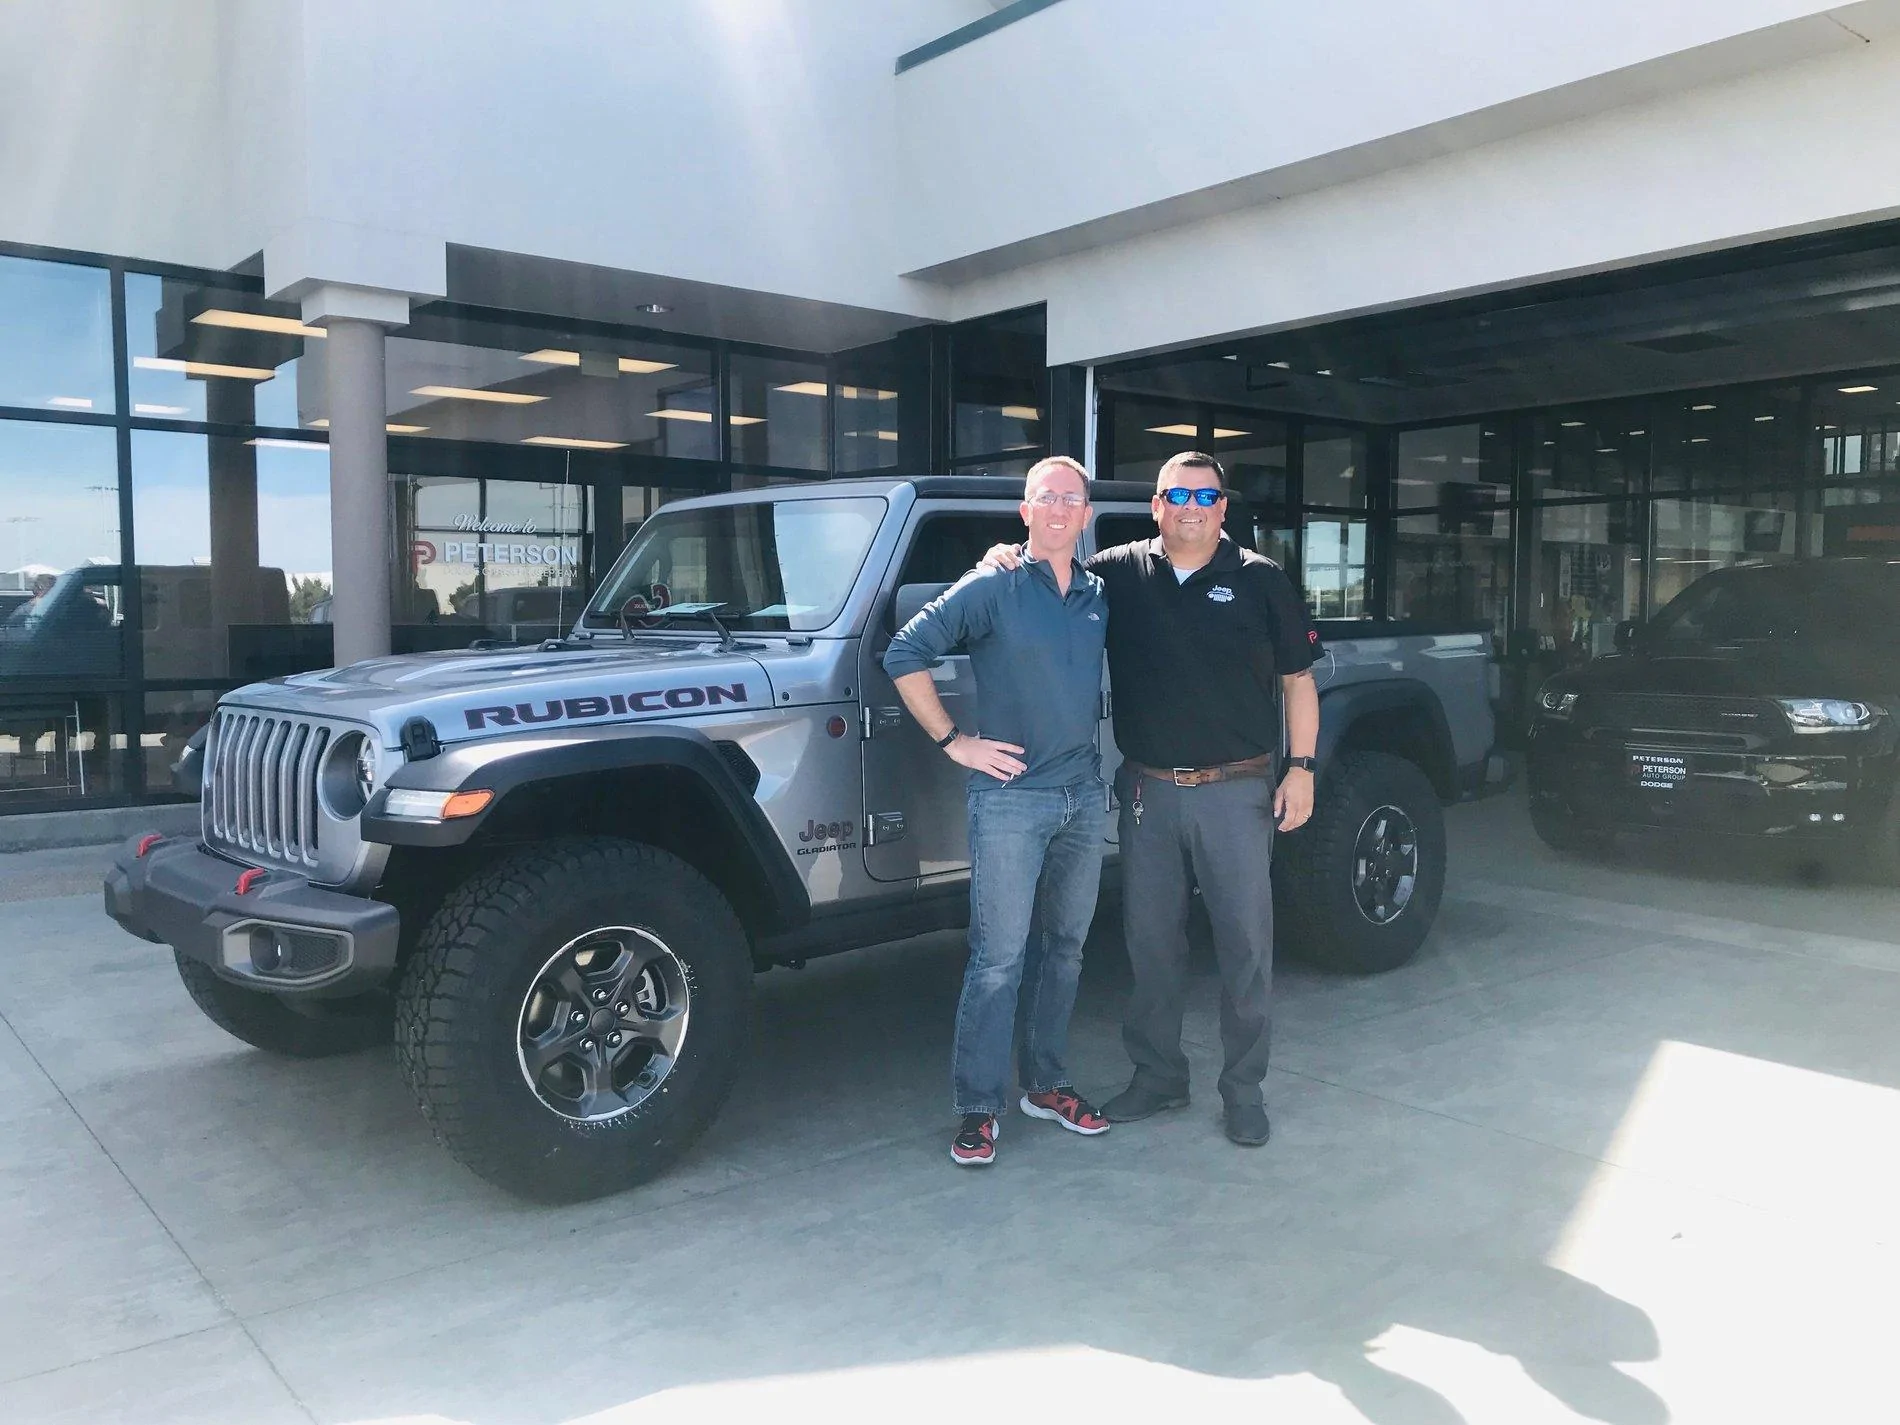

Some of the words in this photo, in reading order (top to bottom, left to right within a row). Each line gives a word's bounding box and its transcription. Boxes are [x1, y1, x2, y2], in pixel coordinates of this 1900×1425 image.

[453, 513, 521, 533] Welcome
[522, 518, 537, 534] to
[444, 541, 578, 566] PETERSON
[1212, 584, 1232, 595] Jeep
[464, 683, 748, 730] RUBICON
[1632, 755, 1684, 764] PETERSON
[1642, 765, 1686, 775] PETERSON
[798, 819, 854, 843] Jeep
[797, 842, 857, 856] GLADIATOR
